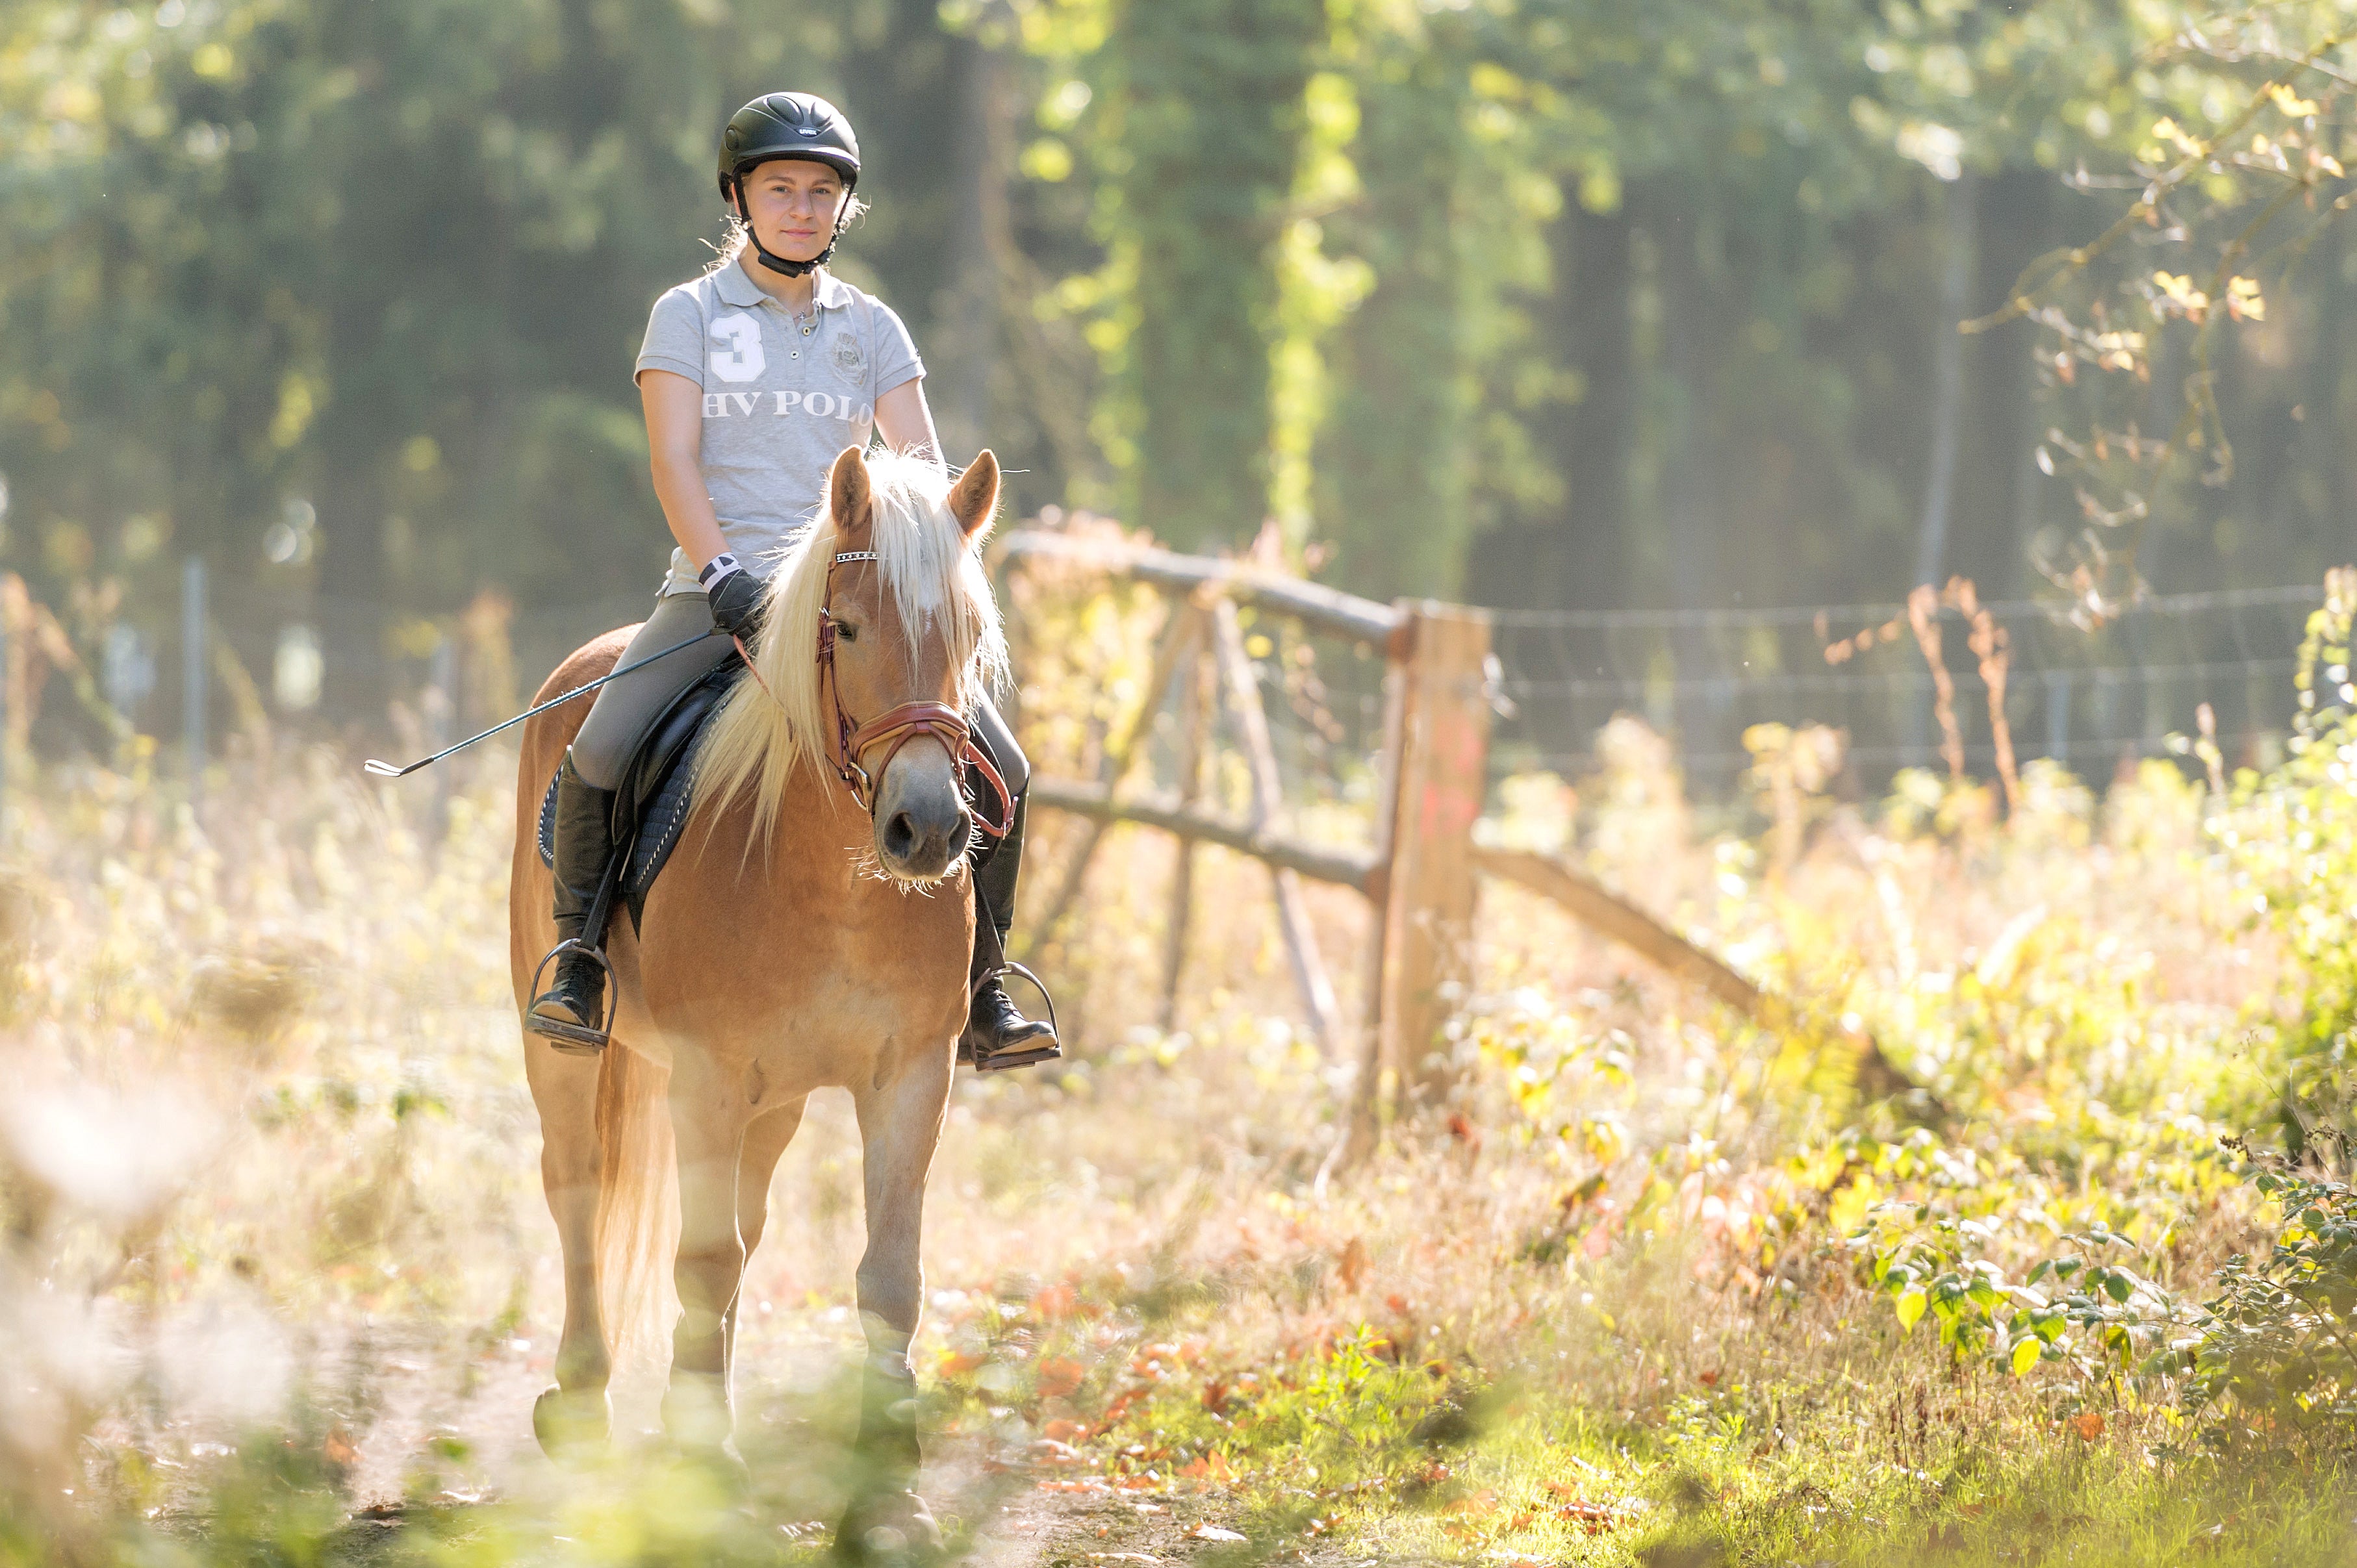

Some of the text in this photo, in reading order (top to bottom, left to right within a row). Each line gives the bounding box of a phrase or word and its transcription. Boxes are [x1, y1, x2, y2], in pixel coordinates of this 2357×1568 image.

[710, 312, 766, 382] 3
[702, 390, 874, 427] HV POLO
